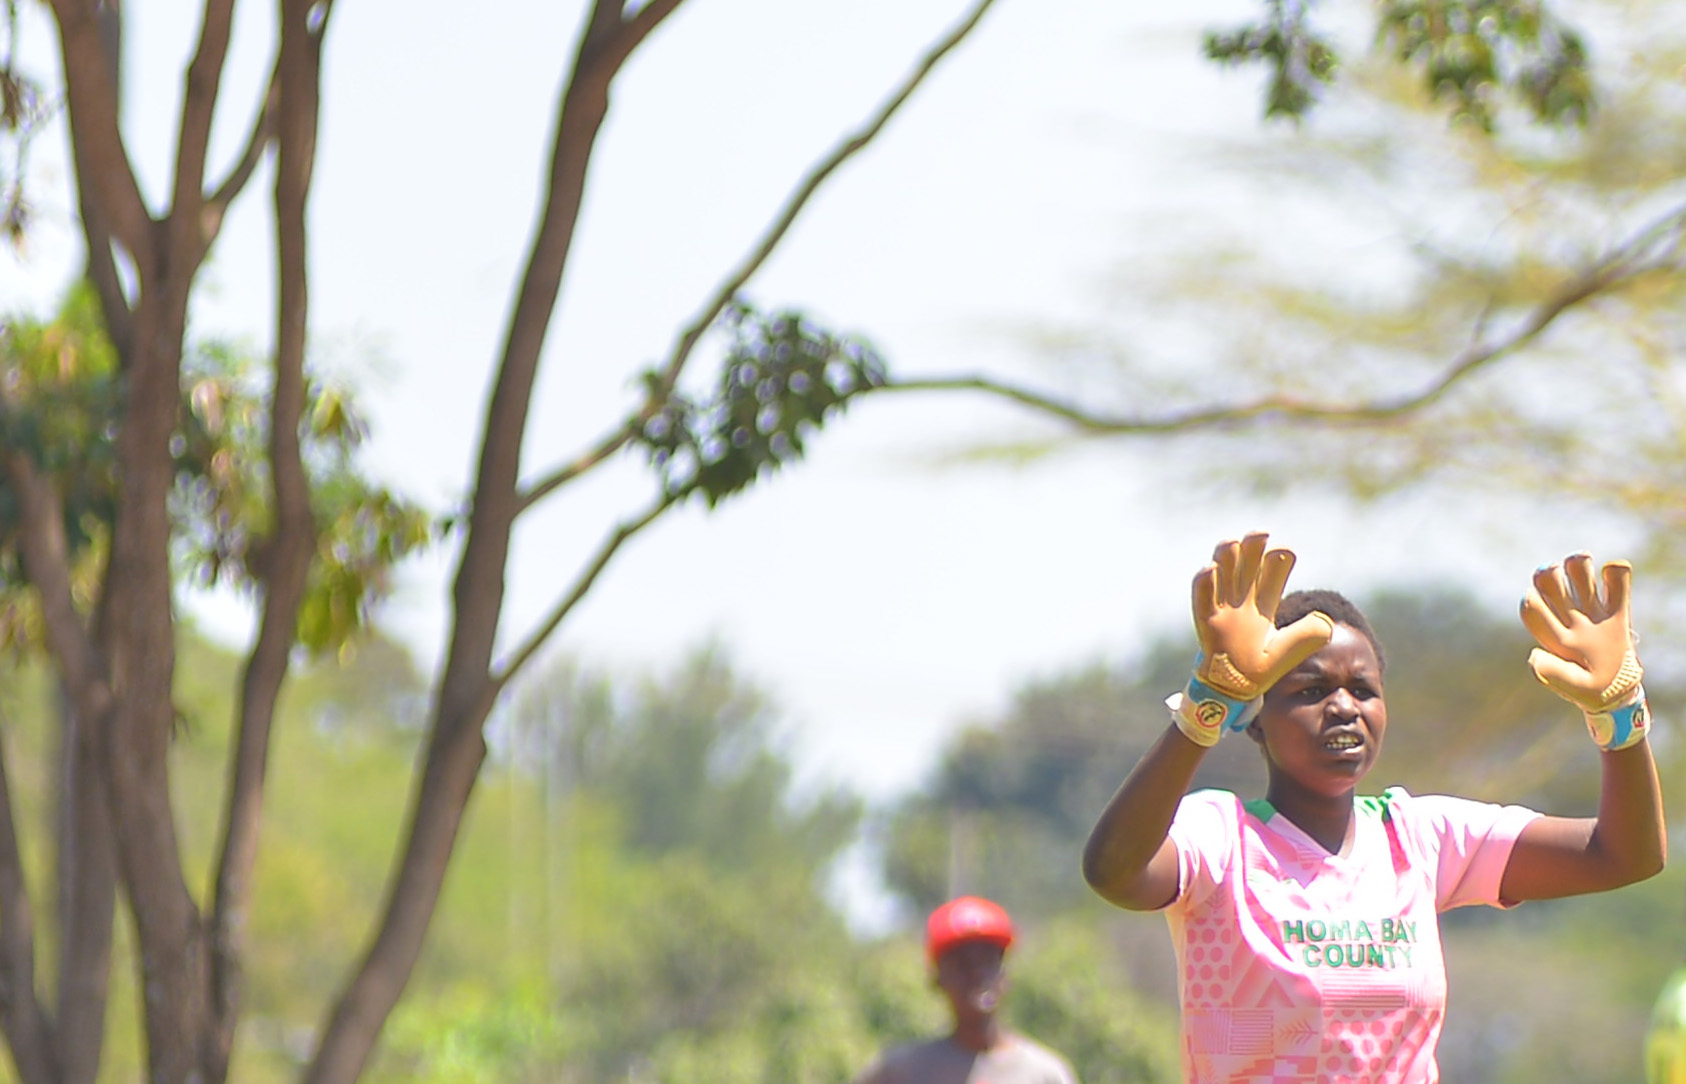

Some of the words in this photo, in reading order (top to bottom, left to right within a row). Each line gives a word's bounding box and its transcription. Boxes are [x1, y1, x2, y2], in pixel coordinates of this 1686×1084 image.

[1283, 919, 1373, 942] HOMA
[1381, 917, 1417, 943] BAY
[1302, 943, 1412, 969] COUNTY
